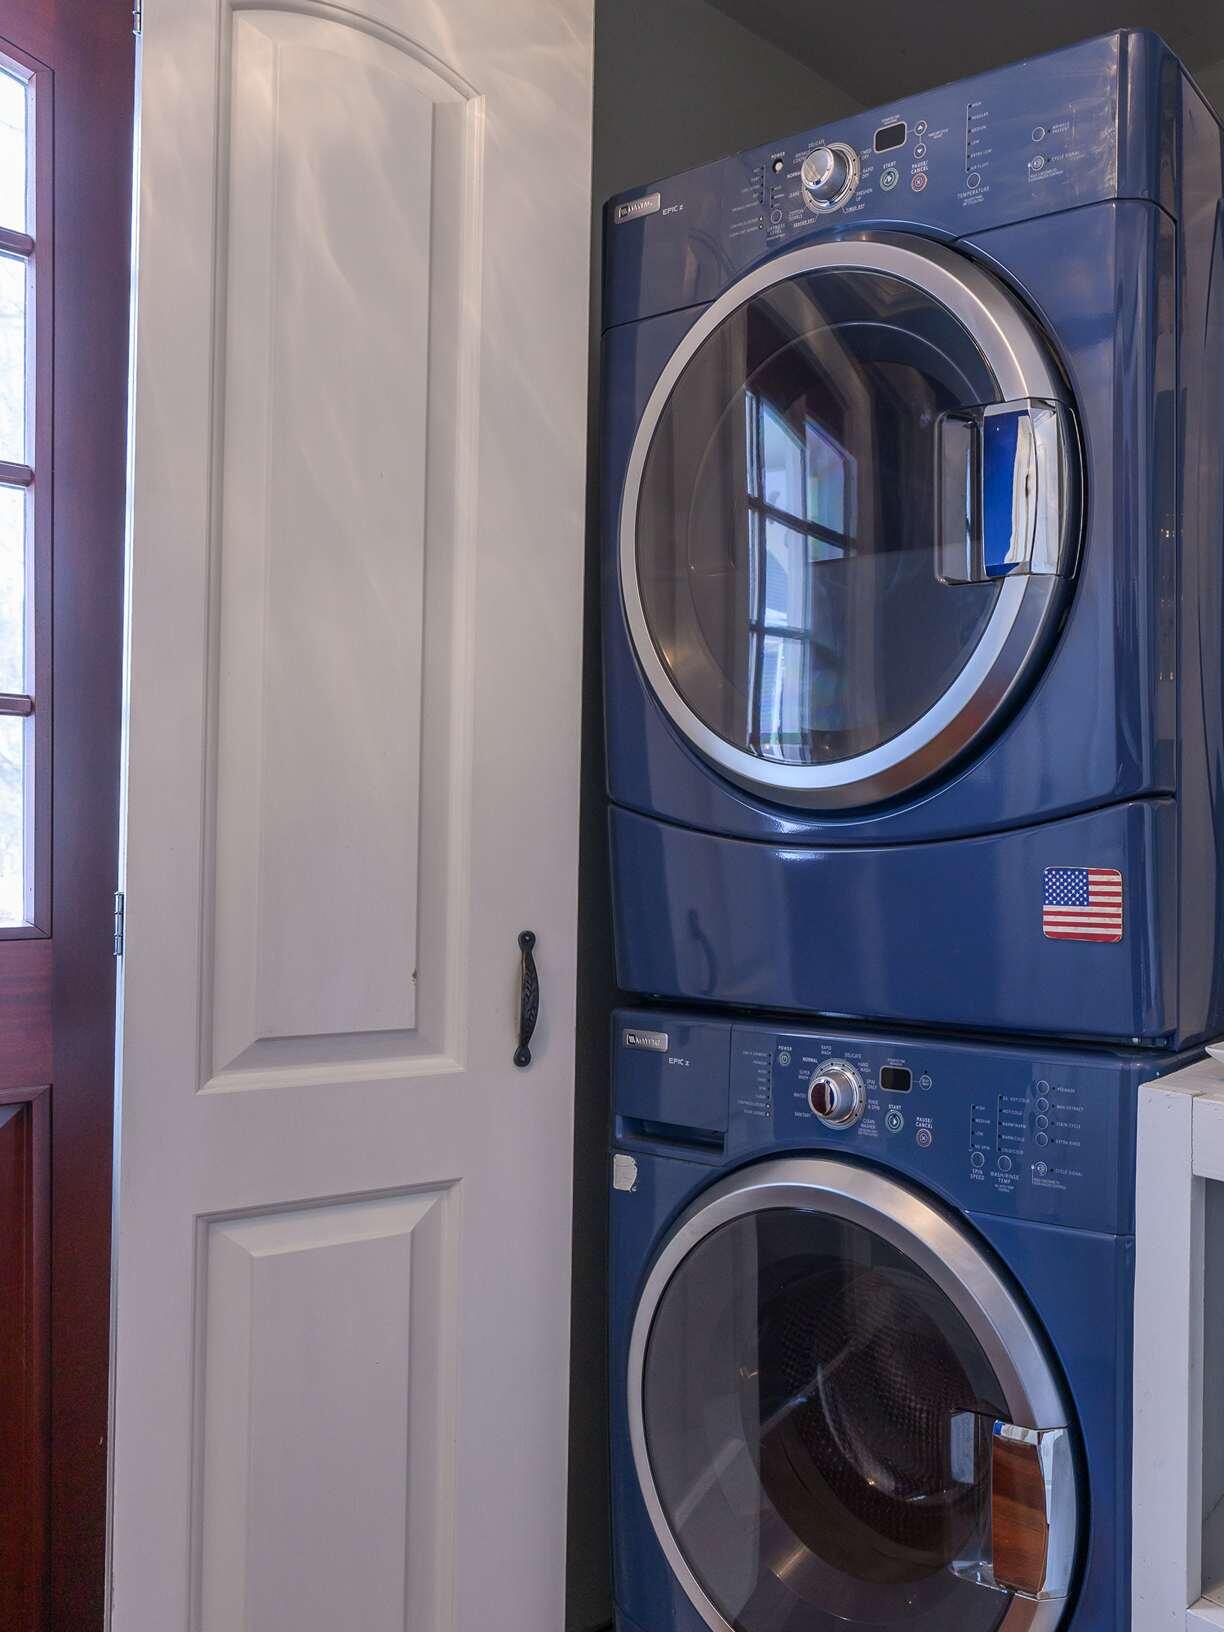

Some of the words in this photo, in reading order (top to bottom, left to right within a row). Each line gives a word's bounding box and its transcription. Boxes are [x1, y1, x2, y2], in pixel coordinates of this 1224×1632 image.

[883, 161, 897, 169] START
[957, 186, 990, 199] TEMPERATURE
[668, 1057, 684, 1066] EPIC
